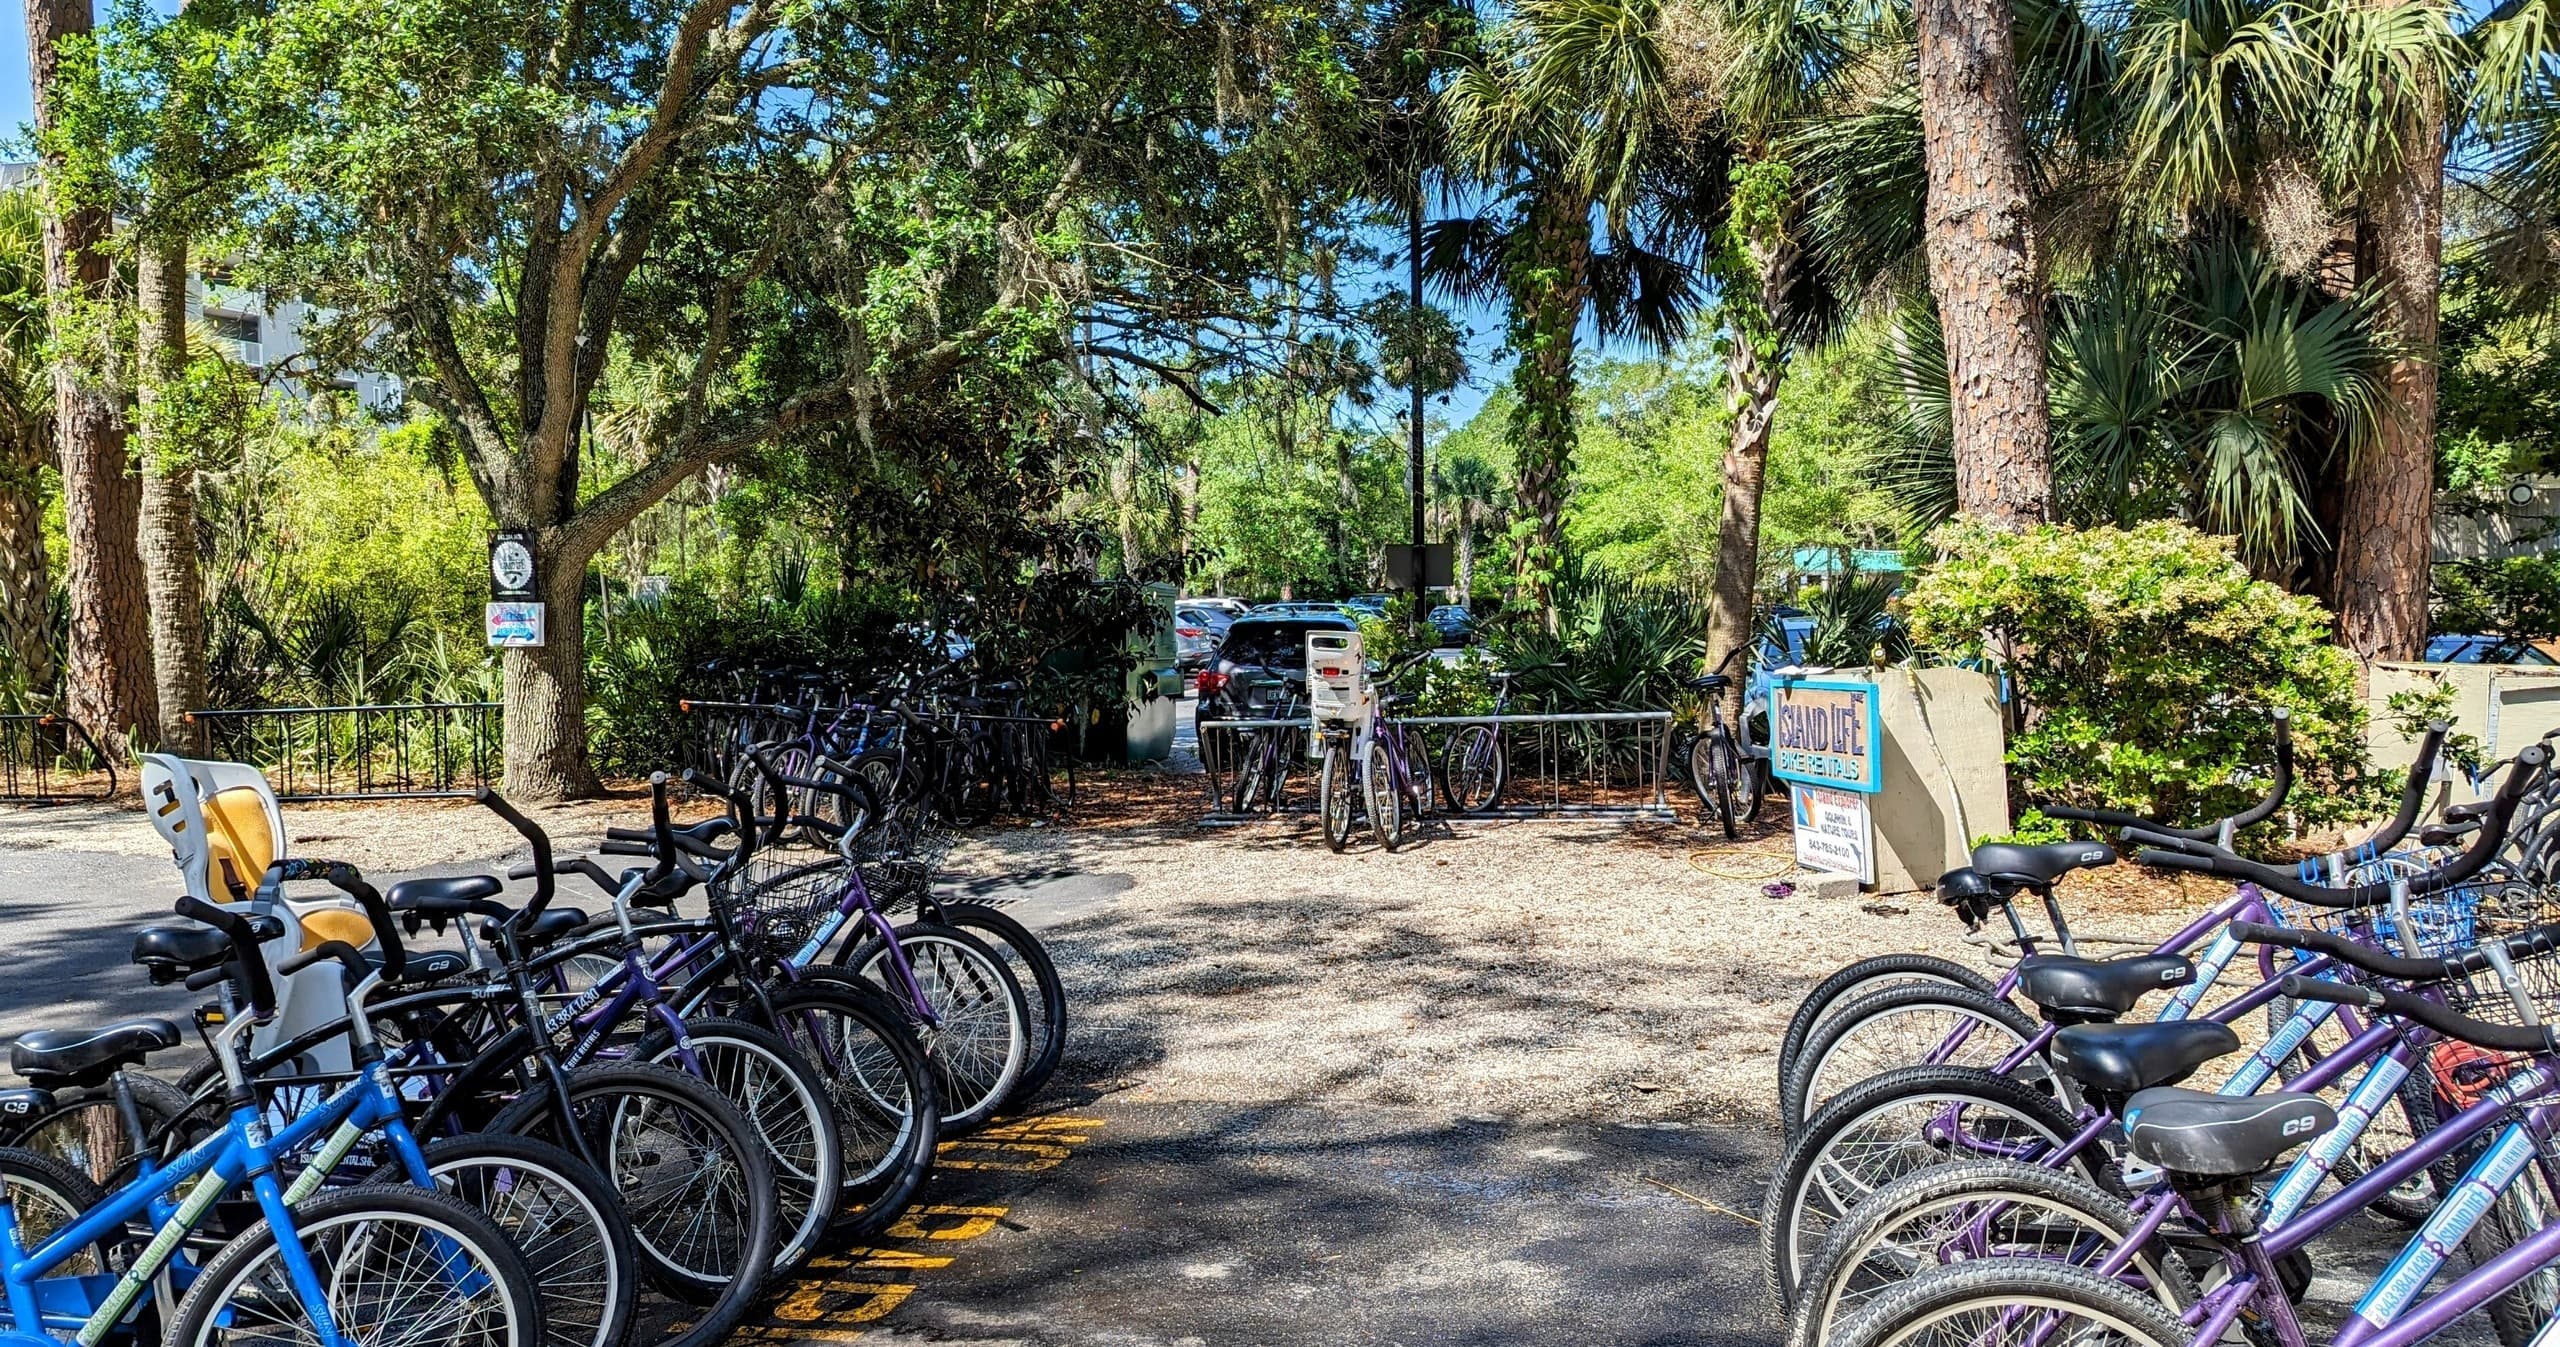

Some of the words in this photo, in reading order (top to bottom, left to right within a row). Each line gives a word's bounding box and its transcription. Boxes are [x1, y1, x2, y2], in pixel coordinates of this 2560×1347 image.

[1777, 692, 1828, 751] ISLAND
[1830, 691, 1864, 756] LIFE
[1781, 751, 1805, 773] BIKE
[1807, 754, 1860, 781] RENTALS
[2081, 850, 2104, 862] C9
[251, 921, 262, 933] 9
[428, 960, 450, 972] C9
[2160, 966, 2187, 981] C9
[544, 987, 600, 1035] 43.384.1430
[567, 1048, 584, 1068] BIKE
[580, 1030, 600, 1056] RENTALS
[4, 1102, 29, 1114] C9
[2283, 1115, 2316, 1137] C9
[2266, 1164, 2321, 1224] 843.384.1430
[2316, 1126, 2351, 1163] ISLAND
[2343, 1108, 2364, 1133] LIFE
[2362, 1089, 2380, 1108] BIKE
[2373, 1061, 2401, 1091] RENTALS
[2373, 1248, 2436, 1318] 843.384.1430
[2431, 1205, 2474, 1248] ISLAND
[2464, 1182, 2491, 1214] LIFE
[2486, 1161, 2509, 1185] BIKE
[2500, 1135, 2530, 1167] RENTAL
[309, 1303, 337, 1337] SUN
